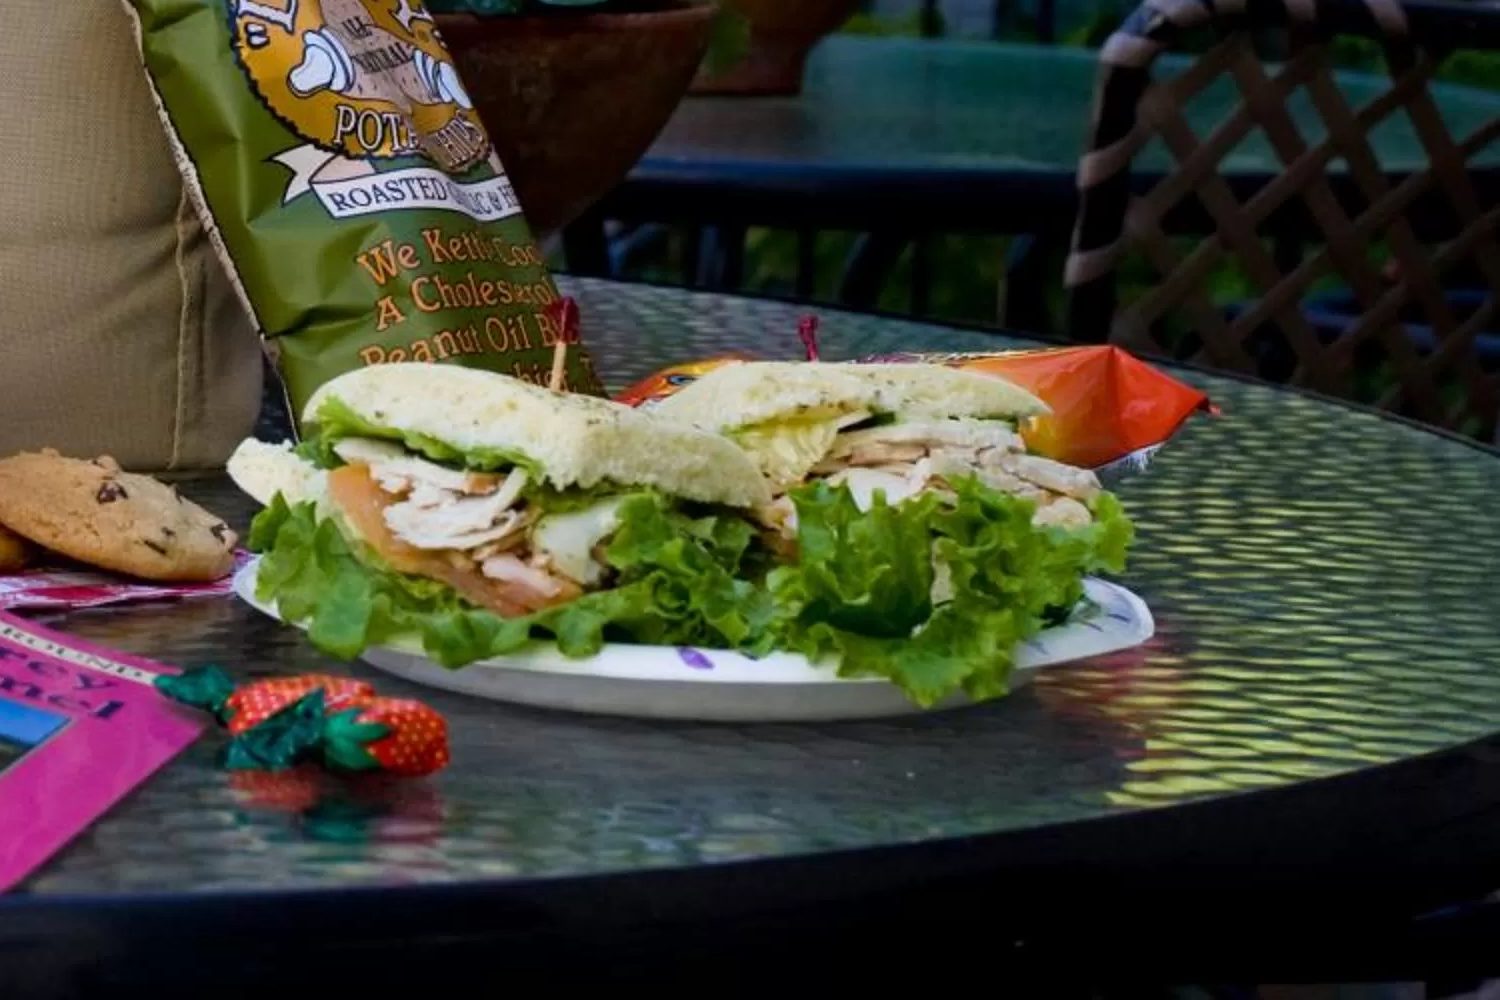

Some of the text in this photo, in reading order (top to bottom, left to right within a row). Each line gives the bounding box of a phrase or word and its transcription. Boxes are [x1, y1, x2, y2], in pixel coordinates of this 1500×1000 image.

[341, 16, 373, 38] ALL
[326, 176, 448, 213] ROASTED
[357, 240, 421, 286] We
[376, 295, 406, 332] A
[360, 325, 484, 367] Peanut
[485, 313, 532, 352] Oil
